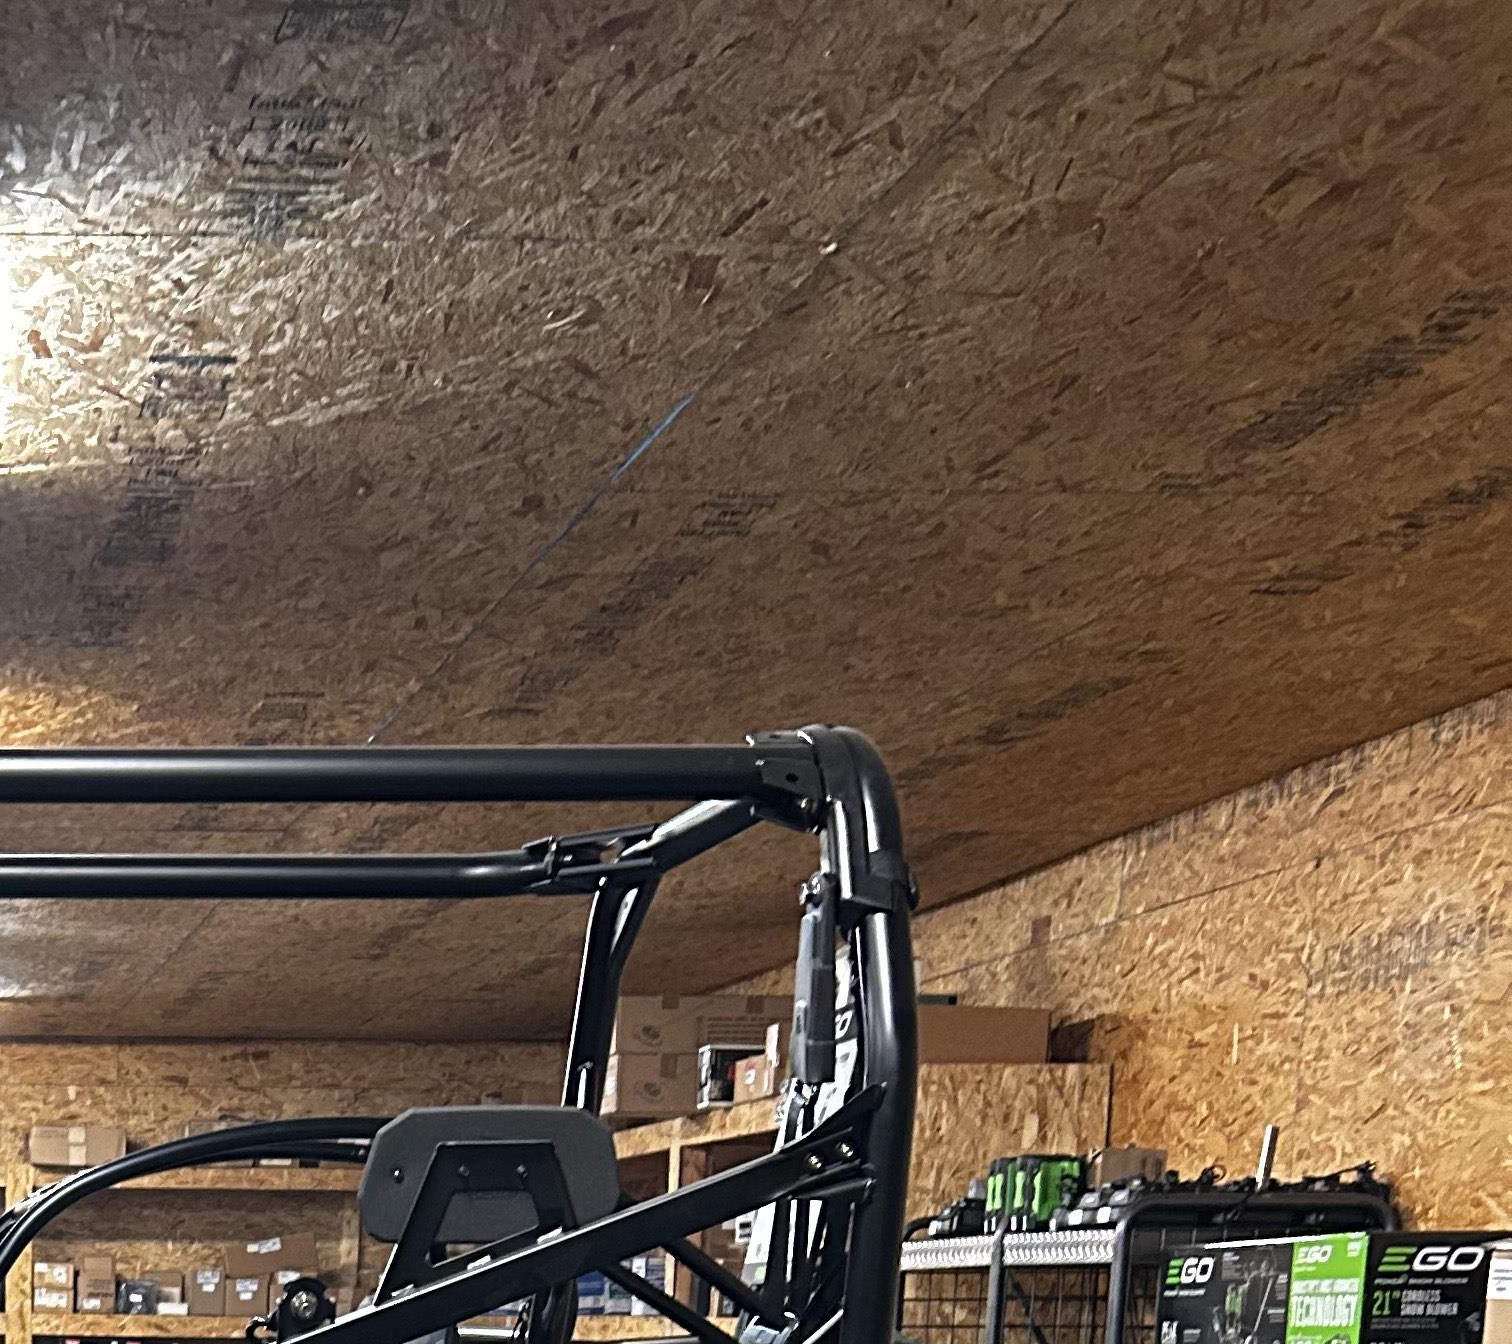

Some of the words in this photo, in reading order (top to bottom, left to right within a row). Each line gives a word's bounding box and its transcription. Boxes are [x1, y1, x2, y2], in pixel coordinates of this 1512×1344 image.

[1296, 1244, 1333, 1264] EGO
[1377, 1245, 1485, 1272] EGO
[1165, 1256, 1215, 1285] EGO
[1290, 1294, 1358, 1328] TECHNOLOGY
